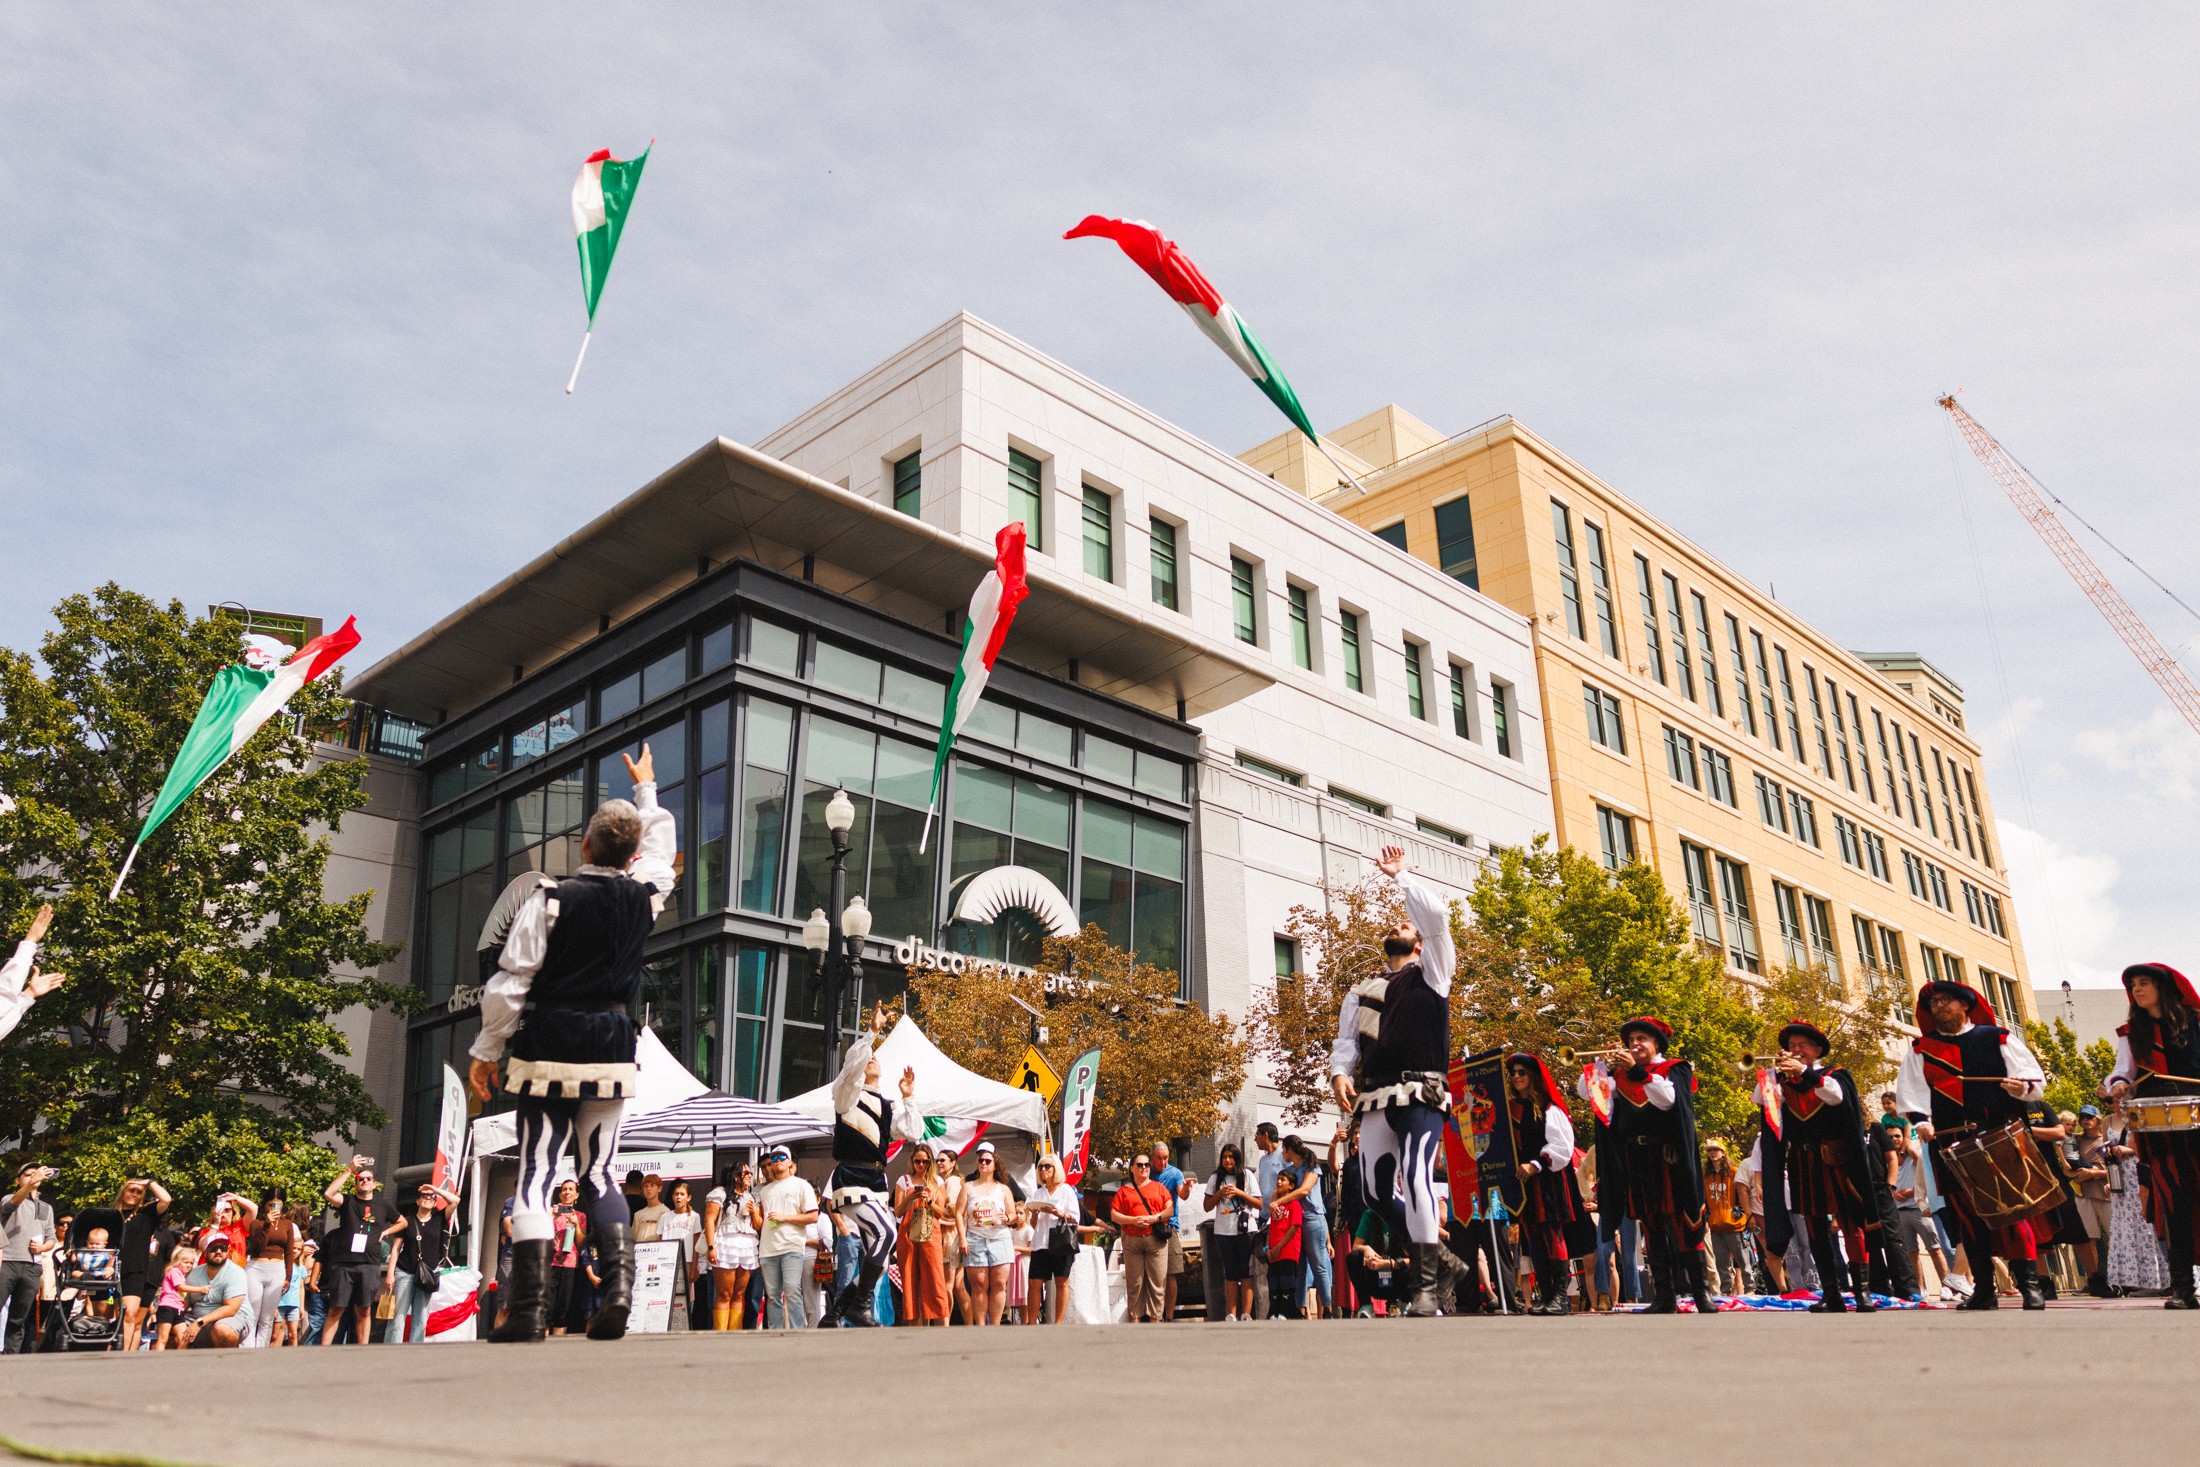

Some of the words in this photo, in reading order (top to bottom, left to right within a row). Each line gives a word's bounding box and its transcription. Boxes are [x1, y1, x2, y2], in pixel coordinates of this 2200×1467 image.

[447, 984, 485, 1014] disco
[1068, 1065, 1092, 1174] PIZZA
[632, 1161, 661, 1172] PIZZERIA
[1481, 1161, 1506, 1173] Parma
